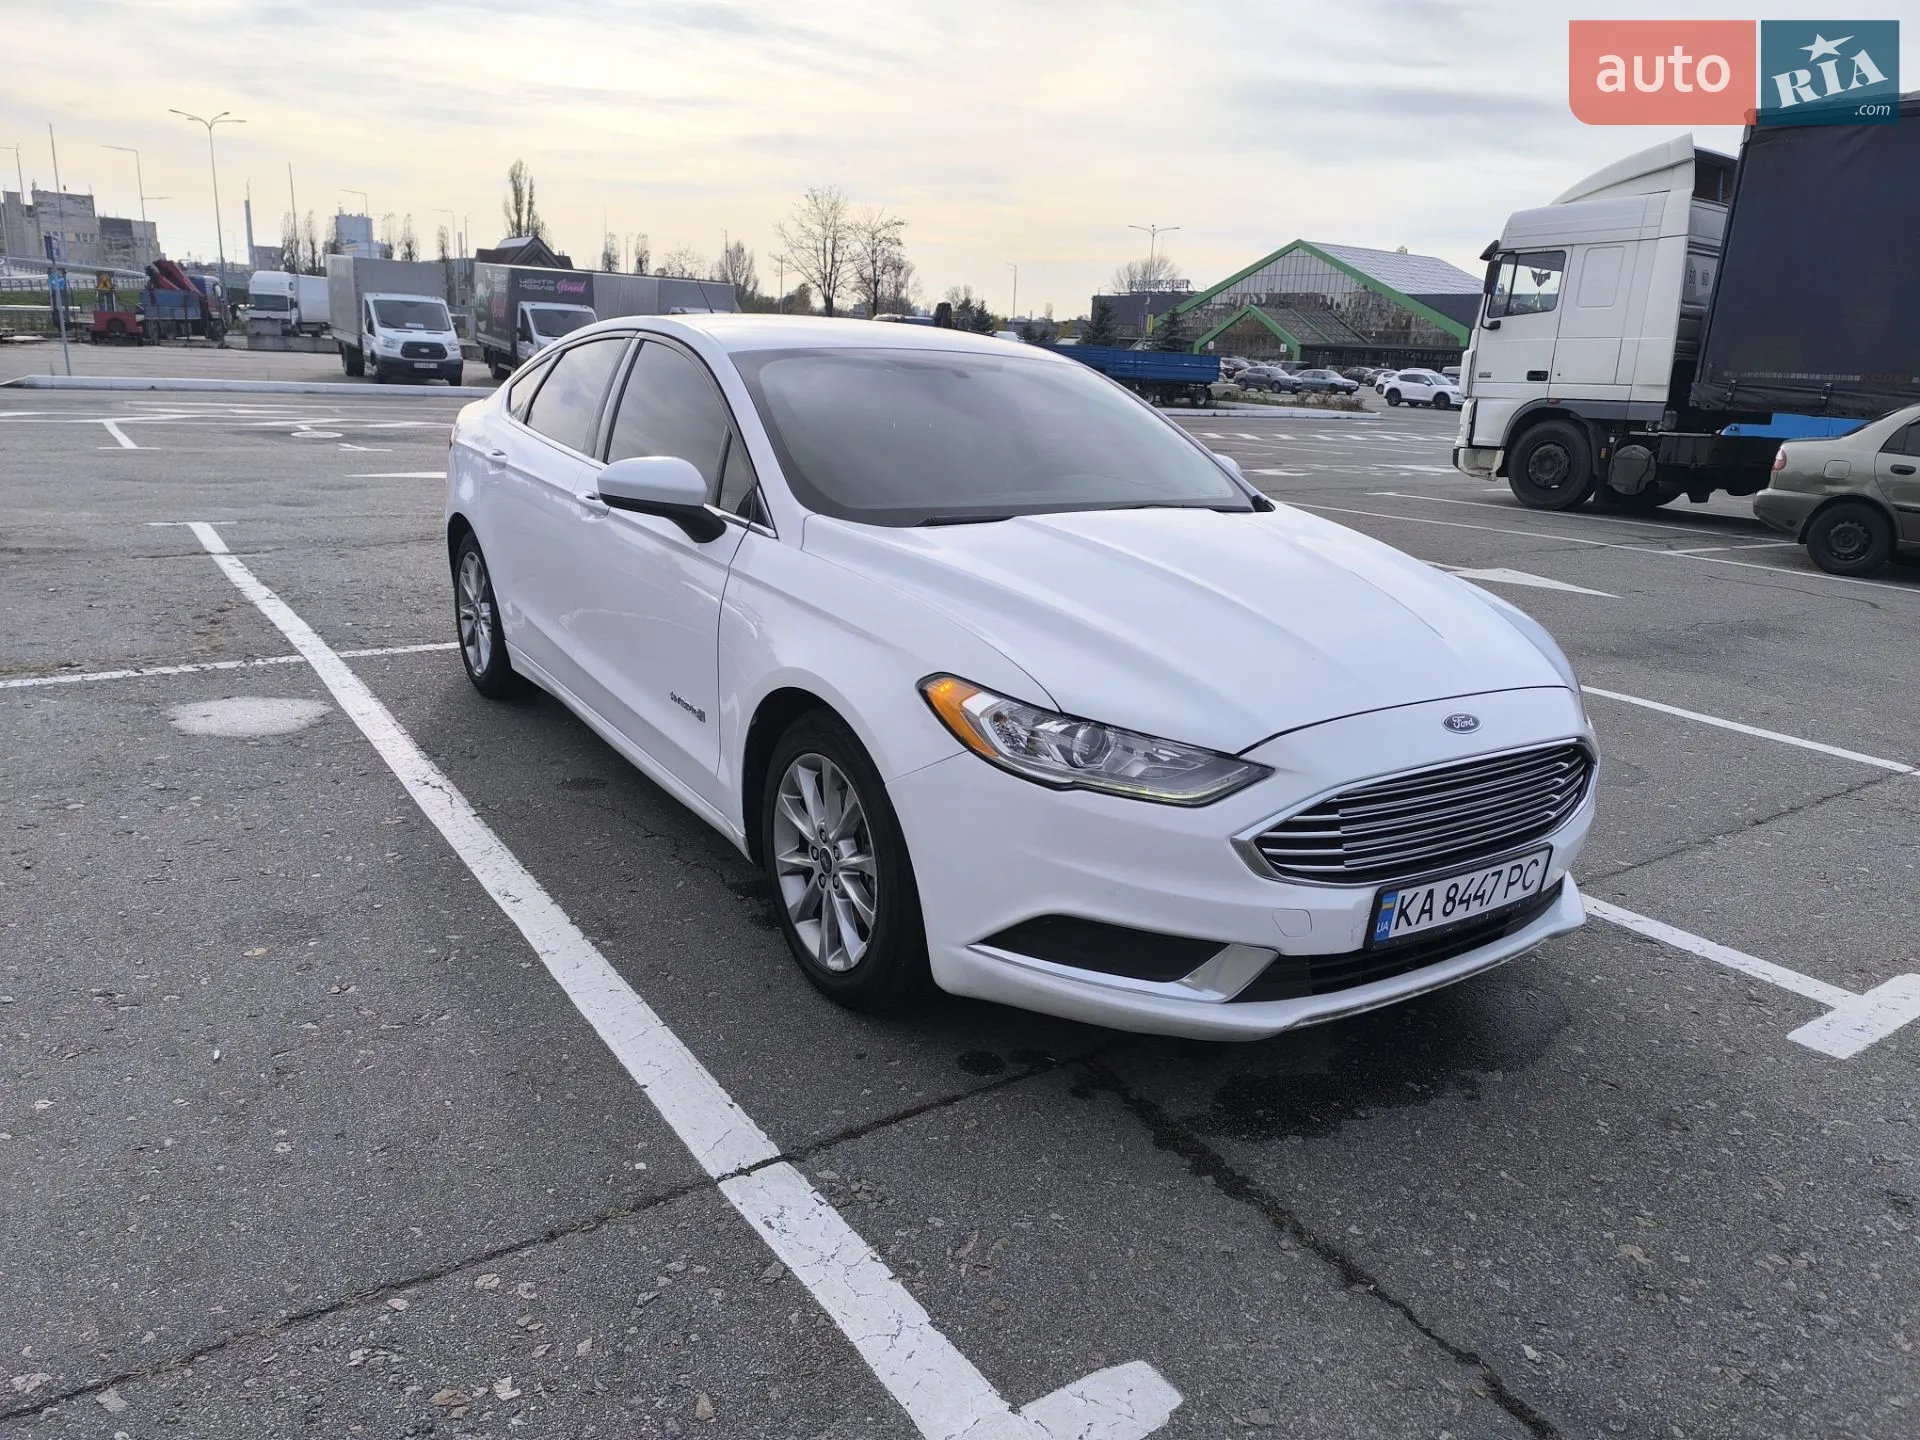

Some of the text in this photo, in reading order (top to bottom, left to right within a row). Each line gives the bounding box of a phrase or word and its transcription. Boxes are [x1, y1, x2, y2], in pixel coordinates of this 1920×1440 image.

[1395, 858, 1540, 930] KA 8447 PC
[1376, 920, 1390, 933] UA
